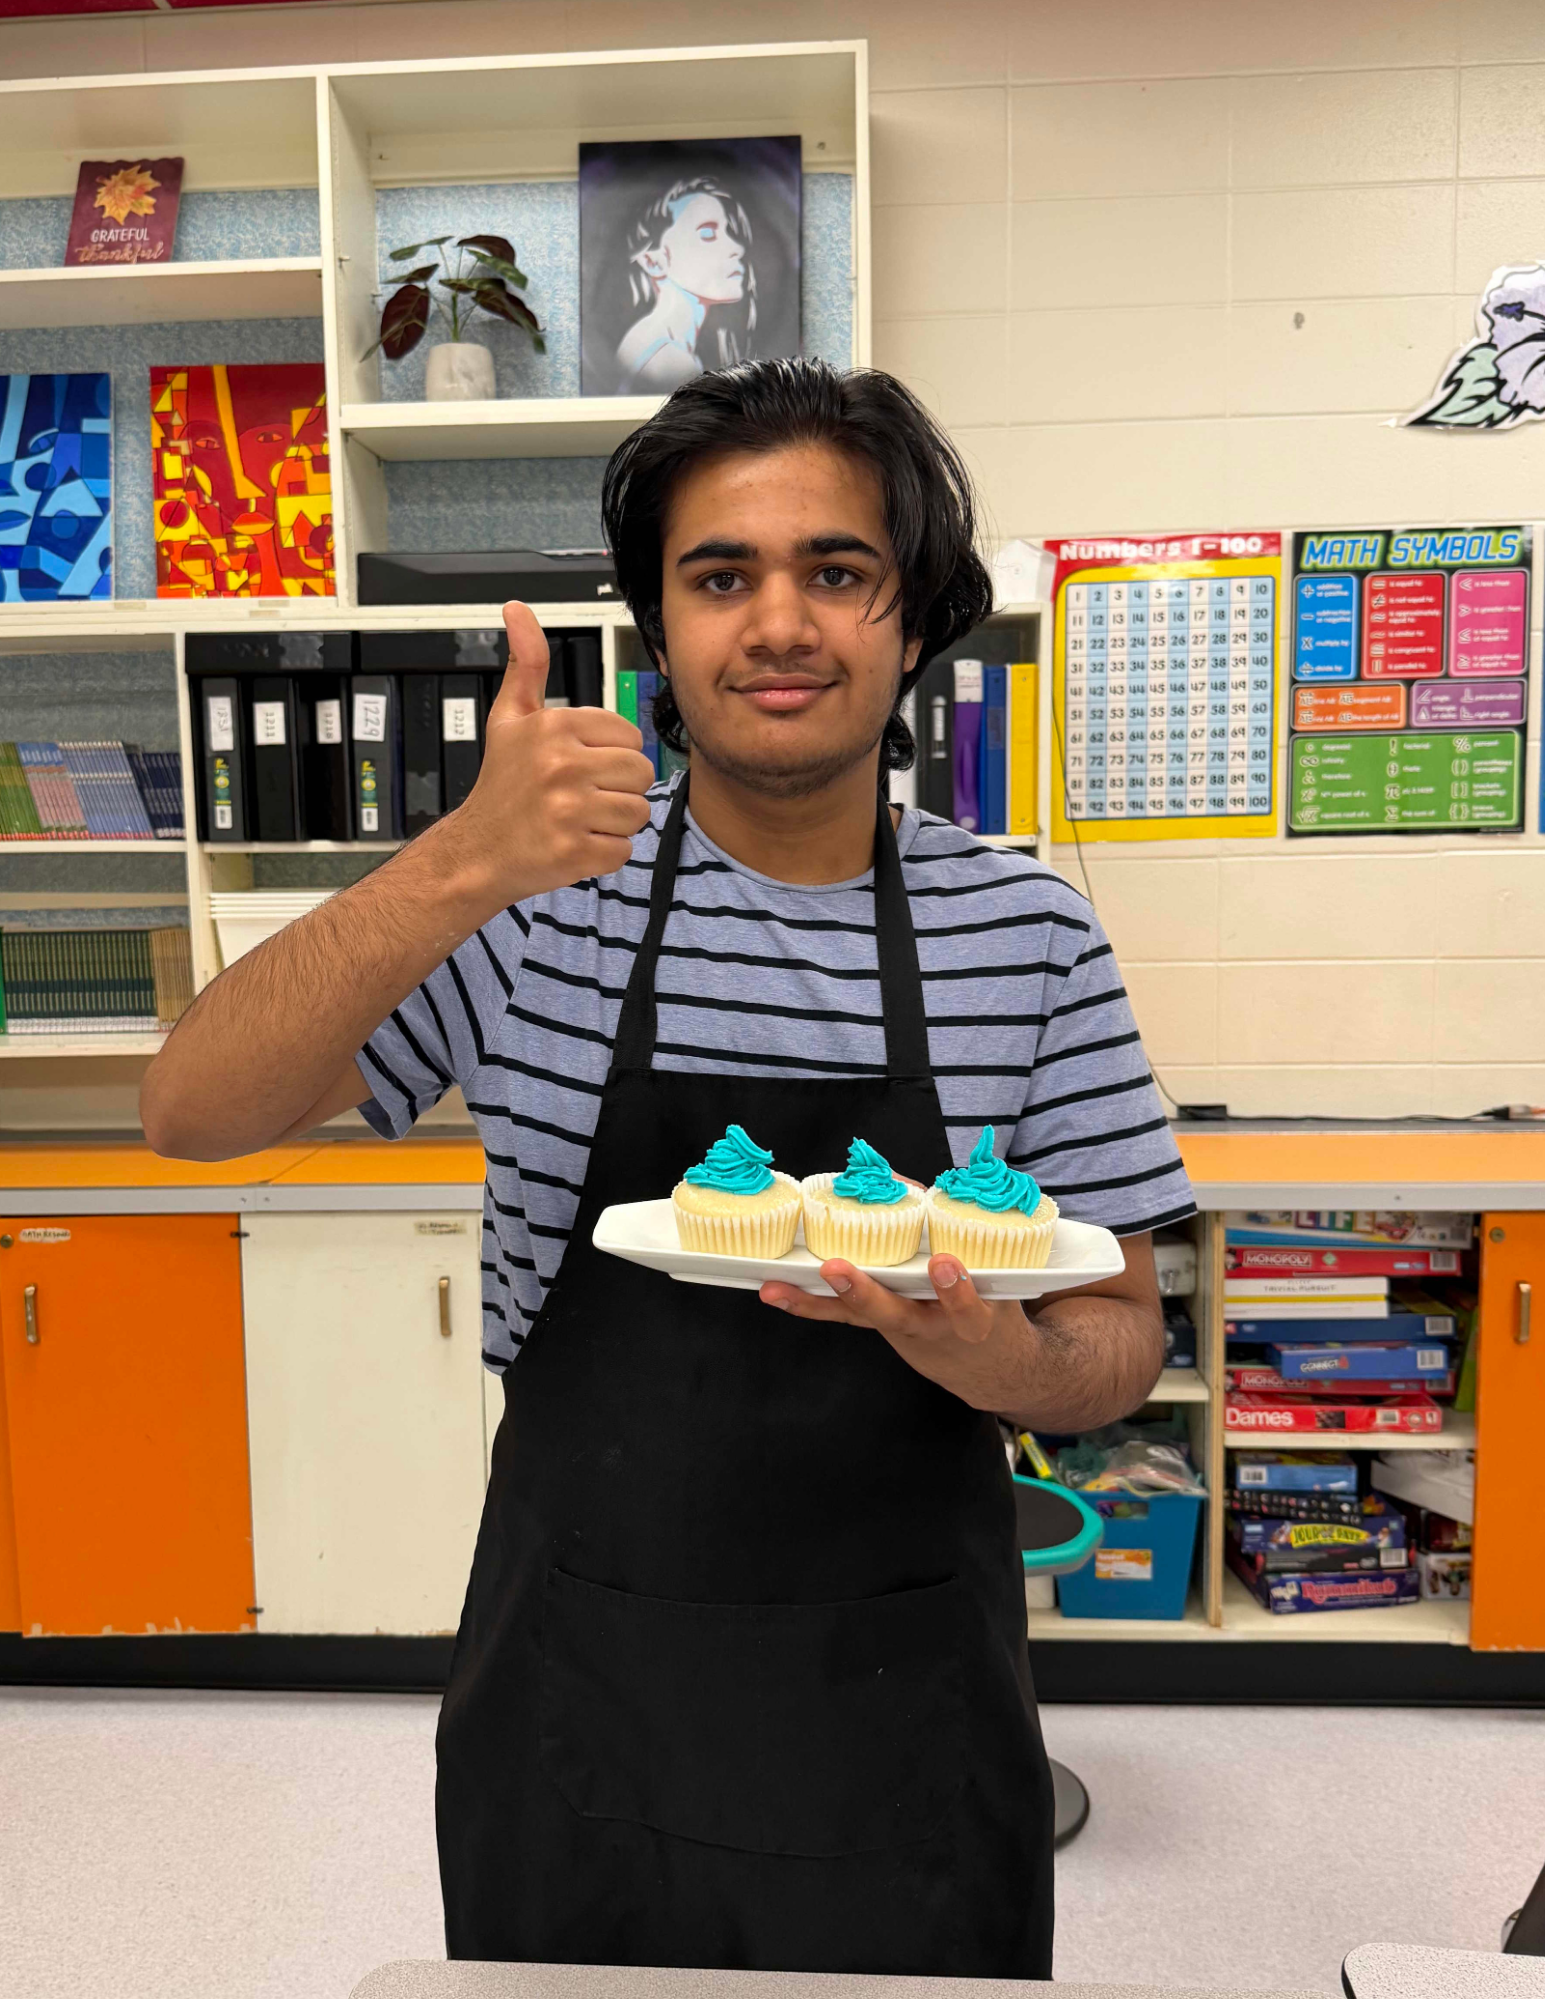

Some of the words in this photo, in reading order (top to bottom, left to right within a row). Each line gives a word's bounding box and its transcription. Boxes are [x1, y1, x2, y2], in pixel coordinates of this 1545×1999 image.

[91, 228, 149, 243] GRATEFUL
[74, 240, 164, 264] thankful
[1060, 541, 1181, 560] Numbers
[1304, 538, 1379, 566] MATH
[1391, 534, 1518, 563] SYMBOLS
[1255, 584, 1268, 595] 10
[1072, 615, 1083, 627] 11
[1092, 614, 1104, 626] 12
[1112, 613, 1124, 625] 13
[1132, 613, 1145, 624] 14
[1153, 611, 1165, 623] 15
[1173, 611, 1186, 622] 16
[1194, 610, 1206, 621] 17
[1214, 610, 1226, 621] 18
[1234, 609, 1246, 619] 19
[1253, 608, 1269, 620] 20
[1071, 639, 1083, 651] 21
[1090, 638, 1105, 650] 22
[1110, 637, 1126, 649] 23
[1130, 637, 1146, 648] 24
[1151, 635, 1166, 647] 25
[1171, 635, 1187, 647] 26
[1192, 634, 1207, 646] 27
[1212, 634, 1227, 645] 28
[1232, 632, 1247, 644] 29
[1253, 632, 1269, 644] 30
[1070, 663, 1083, 674] 31
[1090, 662, 1105, 674] 32
[1110, 661, 1125, 672] 33
[1130, 661, 1146, 672] 34
[1150, 659, 1166, 671] 35
[1170, 659, 1186, 670] 36
[1191, 658, 1206, 669] 37
[1211, 657, 1227, 669] 38
[1232, 656, 1247, 668] 39
[1252, 656, 1269, 667] 40
[1070, 687, 1083, 697] 41
[1089, 686, 1105, 697] 42
[1109, 685, 1125, 696] 43
[1129, 685, 1146, 695] 44
[1149, 683, 1165, 695] 45
[1170, 683, 1186, 694] 46
[1190, 681, 1206, 692] 47
[1210, 681, 1227, 692] 48
[1231, 680, 1247, 691] 49
[1252, 679, 1268, 691] 50
[363, 700, 381, 737] 1229
[1070, 709, 1083, 721] 51
[1090, 709, 1105, 720] 52
[1109, 708, 1125, 720] 53
[1129, 707, 1145, 719] 54
[1150, 706, 1165, 718] 55
[1170, 706, 1186, 717] 56
[1190, 705, 1206, 716] 57
[1211, 704, 1226, 716] 58
[1231, 703, 1246, 715] 59
[1252, 702, 1268, 714] 60
[1070, 733, 1082, 744] 61
[1089, 732, 1104, 744] 62
[1109, 731, 1125, 742] 63
[1128, 731, 1145, 742] 64
[1149, 730, 1165, 741] 65
[1169, 729, 1185, 741] 66
[1190, 728, 1206, 740] 67
[1210, 728, 1226, 739] 68
[1231, 727, 1246, 738] 69
[1252, 726, 1267, 737] 70
[1070, 756, 1083, 767] 71
[1090, 755, 1104, 767] 72
[1109, 754, 1124, 766] 73
[1129, 754, 1145, 765] 74
[1150, 753, 1164, 764] 75
[1170, 752, 1184, 764] 76
[1190, 751, 1205, 762] 77
[1211, 751, 1225, 762] 78
[1231, 750, 1246, 761] 79
[1251, 750, 1267, 761] 80
[1070, 779, 1083, 790] 81
[1089, 778, 1104, 790] 82
[1109, 778, 1124, 789] 83
[1128, 777, 1144, 788] 84
[1149, 776, 1164, 787] 85
[1169, 776, 1184, 787] 86
[1190, 775, 1205, 786] 87
[1210, 774, 1225, 786] 88
[1230, 774, 1245, 785] 89
[1251, 773, 1267, 784] 90
[1069, 802, 1082, 813] 91
[1089, 801, 1104, 813] 92
[1109, 801, 1124, 812] 93
[1128, 800, 1144, 810] 94
[1148, 800, 1164, 811] 95
[1169, 798, 1184, 810] 96
[1189, 798, 1205, 808] 97
[1209, 798, 1225, 809] 98
[1229, 797, 1245, 807] 99
[1249, 795, 1268, 807] 100
[1245, 1252, 1310, 1266] MONOPOLY
[1226, 1407, 1294, 1427] Dames
